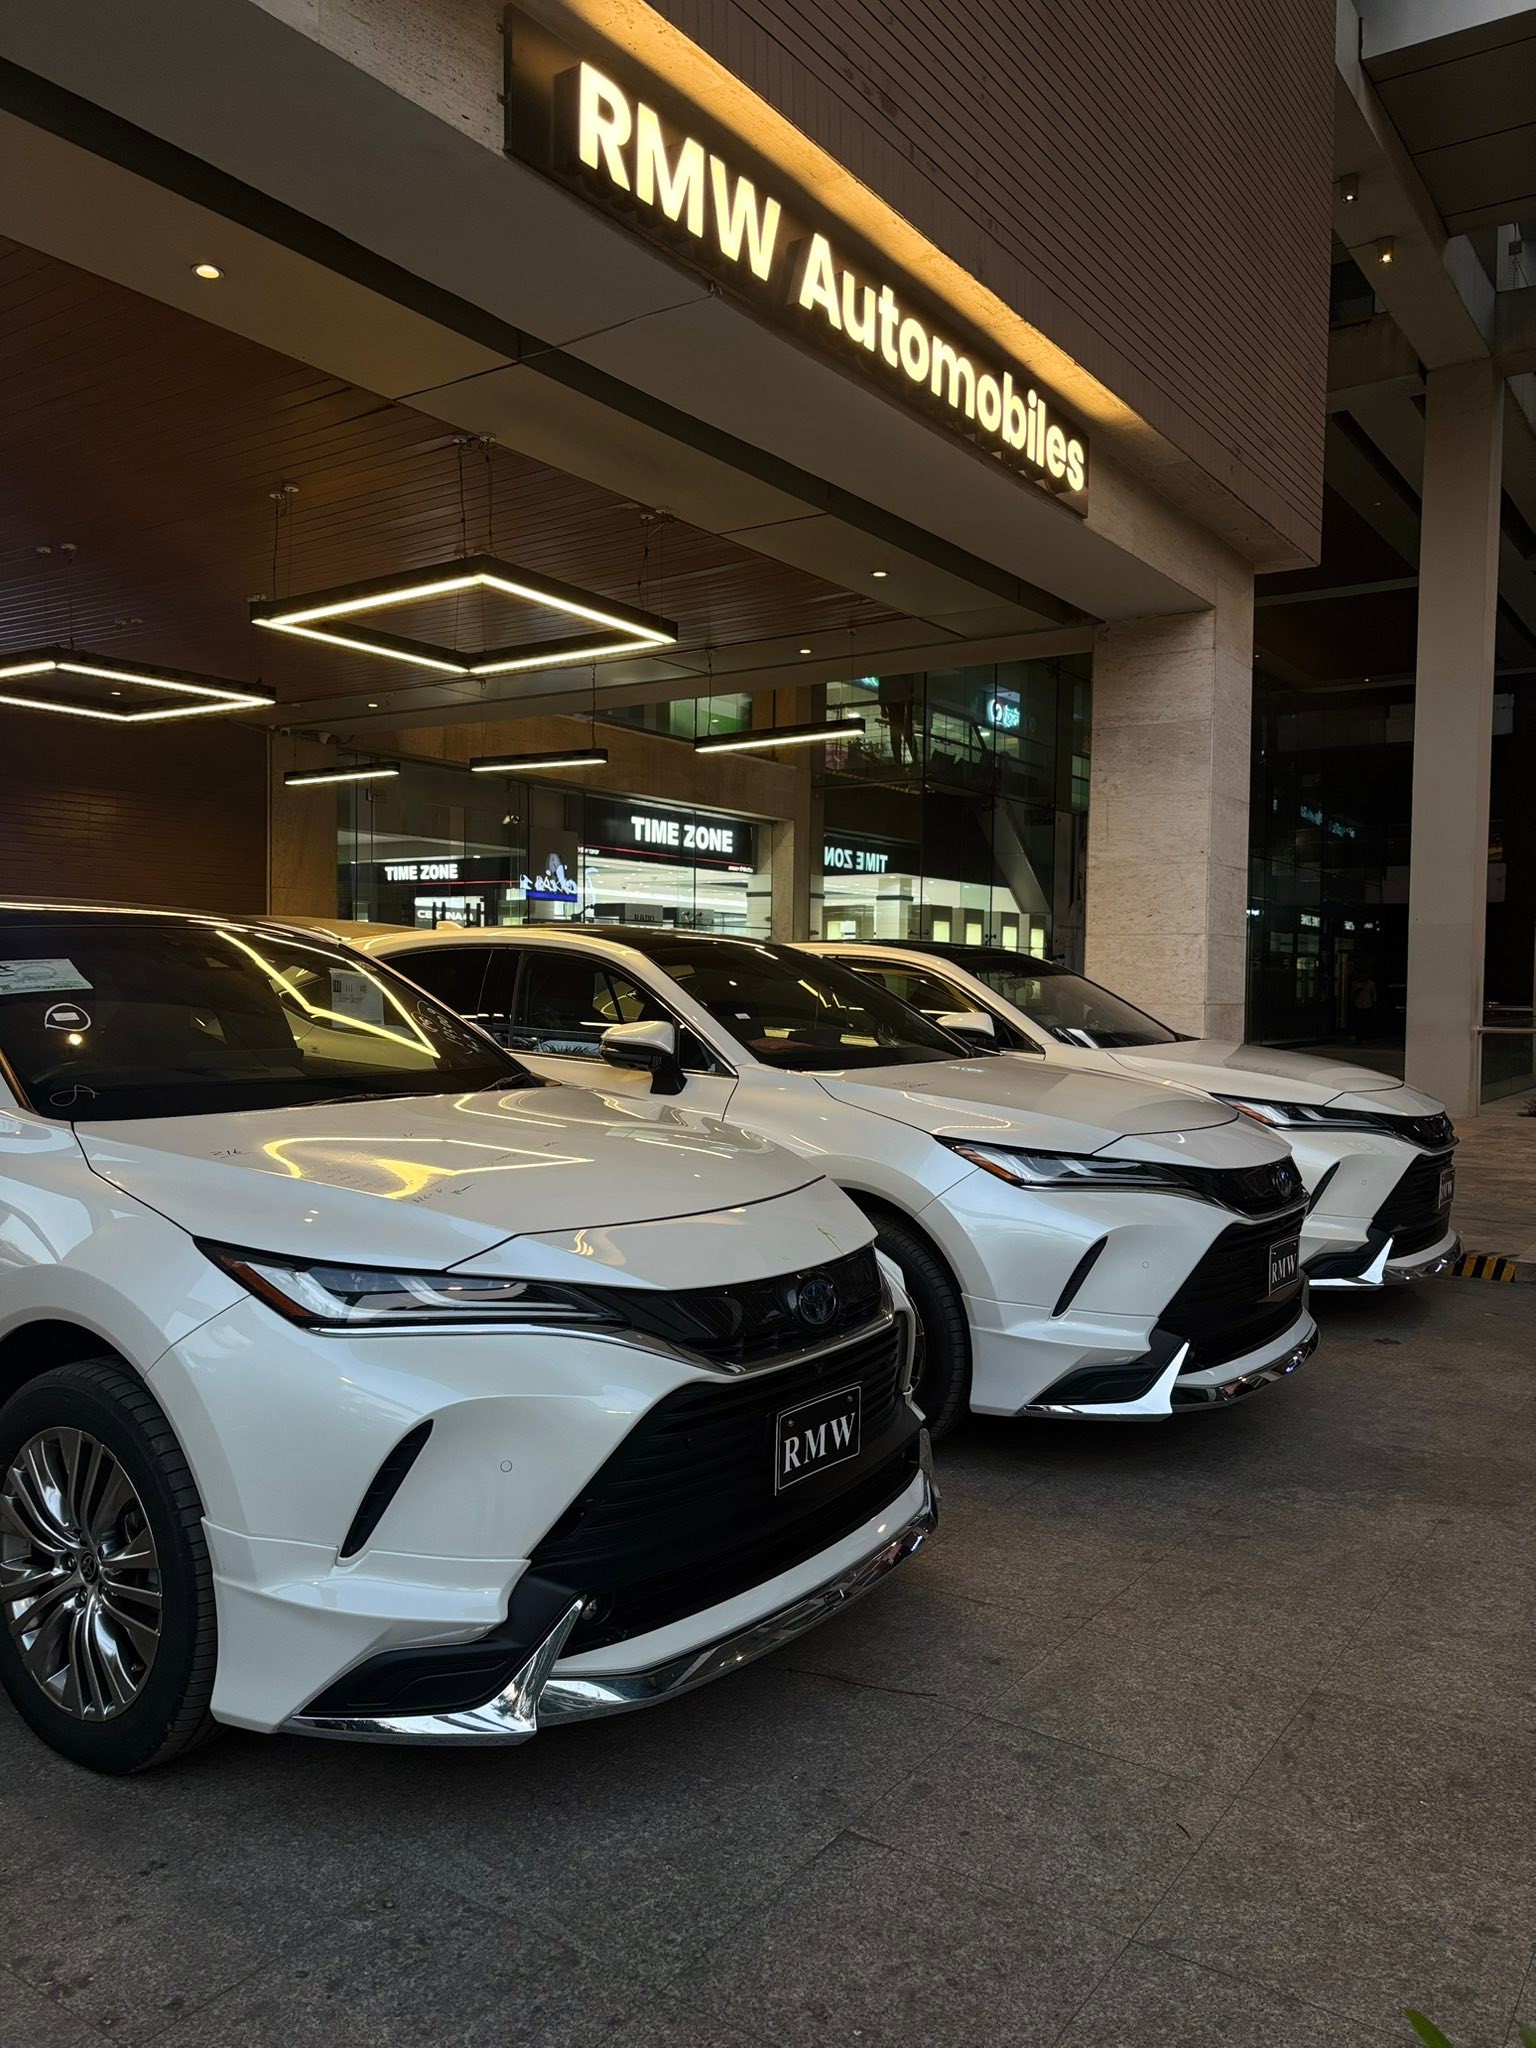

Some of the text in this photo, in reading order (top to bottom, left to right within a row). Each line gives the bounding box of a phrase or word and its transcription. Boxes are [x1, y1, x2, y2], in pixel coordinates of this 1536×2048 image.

[579, 61, 1085, 492] RMW Automobiles
[631, 816, 733, 853] TIME ZONE
[384, 863, 458, 880] TIME ZONE
[417, 910, 463, 921] CETNA
[1271, 1253, 1297, 1283] RMW
[783, 1412, 856, 1474] RMW
